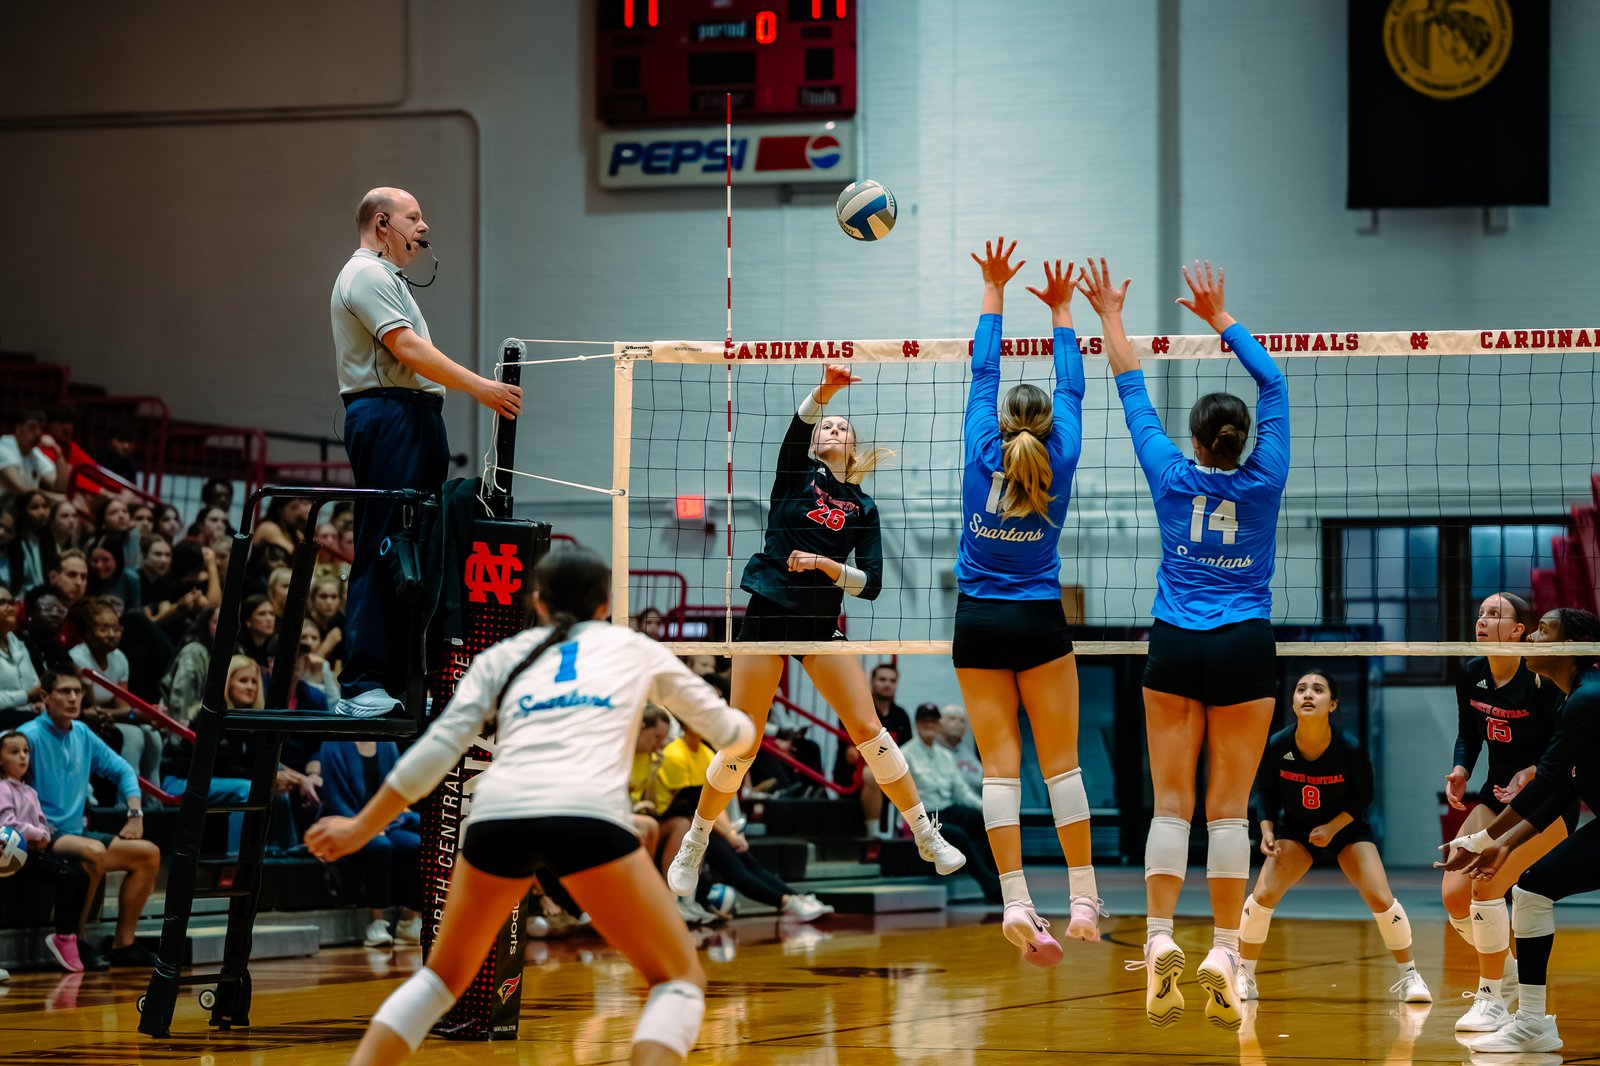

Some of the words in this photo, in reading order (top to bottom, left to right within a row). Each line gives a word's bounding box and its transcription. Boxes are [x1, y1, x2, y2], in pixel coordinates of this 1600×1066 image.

[756, 11, 776, 44] 0
[608, 138, 748, 177] PEPSI
[723, 337, 854, 360] CARDINALS
[969, 337, 1103, 357] RDINLS
[1221, 333, 1359, 353] CRDINALS
[807, 498, 846, 531] 26
[969, 512, 1045, 542] Spartans
[1190, 495, 1239, 545] 14
[1177, 545, 1254, 569] Sartans
[554, 641, 579, 684] 1
[1486, 716, 1512, 743] 15
[1302, 785, 1320, 810] 8
[438, 765, 461, 868] CENTRAL
